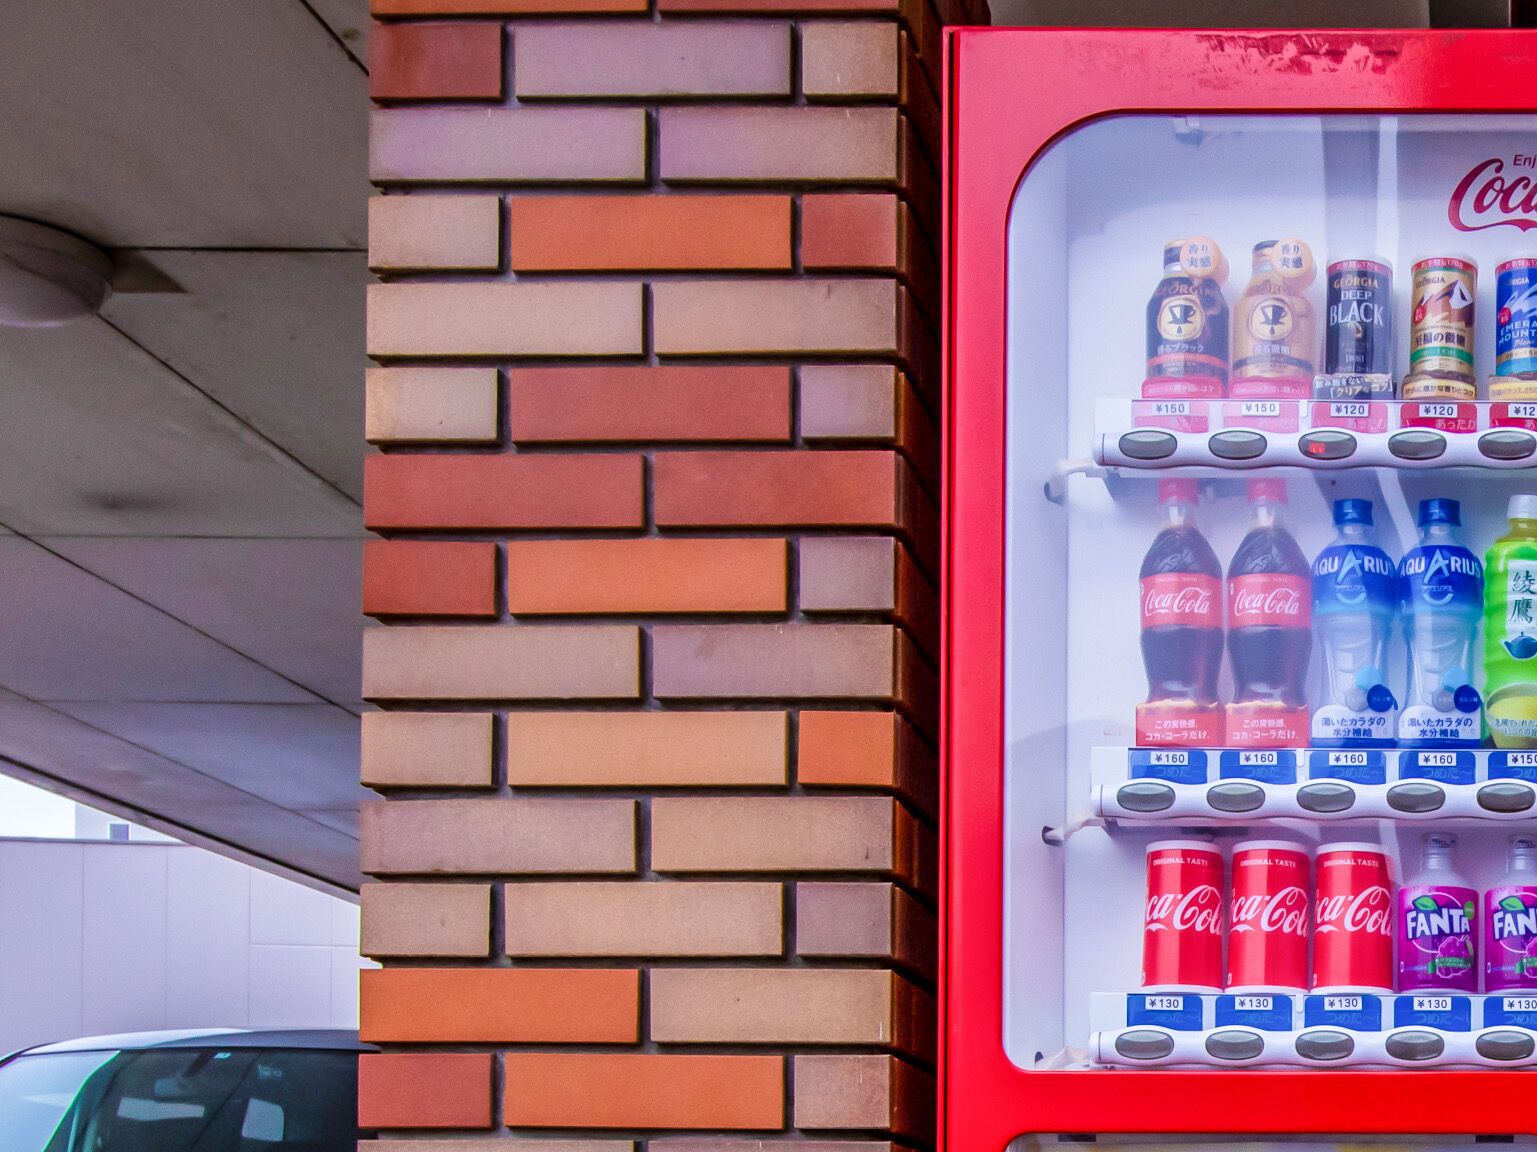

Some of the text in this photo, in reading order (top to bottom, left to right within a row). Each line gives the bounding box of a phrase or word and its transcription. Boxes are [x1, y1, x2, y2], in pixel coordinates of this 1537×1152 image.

[1341, 290, 1372, 300] DEEP
[1330, 301, 1384, 327] BLACK
[1156, 403, 1186, 414] ¥150
[1245, 402, 1276, 414] ¥150
[1335, 405, 1365, 415] ¥120
[1424, 406, 1454, 416] ¥120
[1145, 587, 1212, 617] Coca-Cola
[1234, 588, 1301, 616] Coca-Cola
[1512, 570, 1537, 624] 綾鷹
[1332, 727, 1373, 738] 水分補給
[1418, 727, 1460, 738] 水分補給
[1154, 753, 1185, 764] ¥160
[1244, 752, 1274, 764] ¥160
[1334, 754, 1364, 764] ¥160
[1423, 754, 1454, 764] ¥160
[1153, 857, 1208, 867] ORIGINAL TASTE
[1240, 858, 1296, 868] ORIGINAL TASTE
[1324, 858, 1380, 868] ORIGINAL TASTE
[1406, 908, 1470, 940] FANTA
[1149, 998, 1180, 1009] ¥130
[1238, 998, 1270, 1008] ¥130
[1328, 998, 1358, 1008] ¥130
[1417, 1000, 1448, 1009] ¥130
[1507, 1000, 1537, 1010] ¥130
